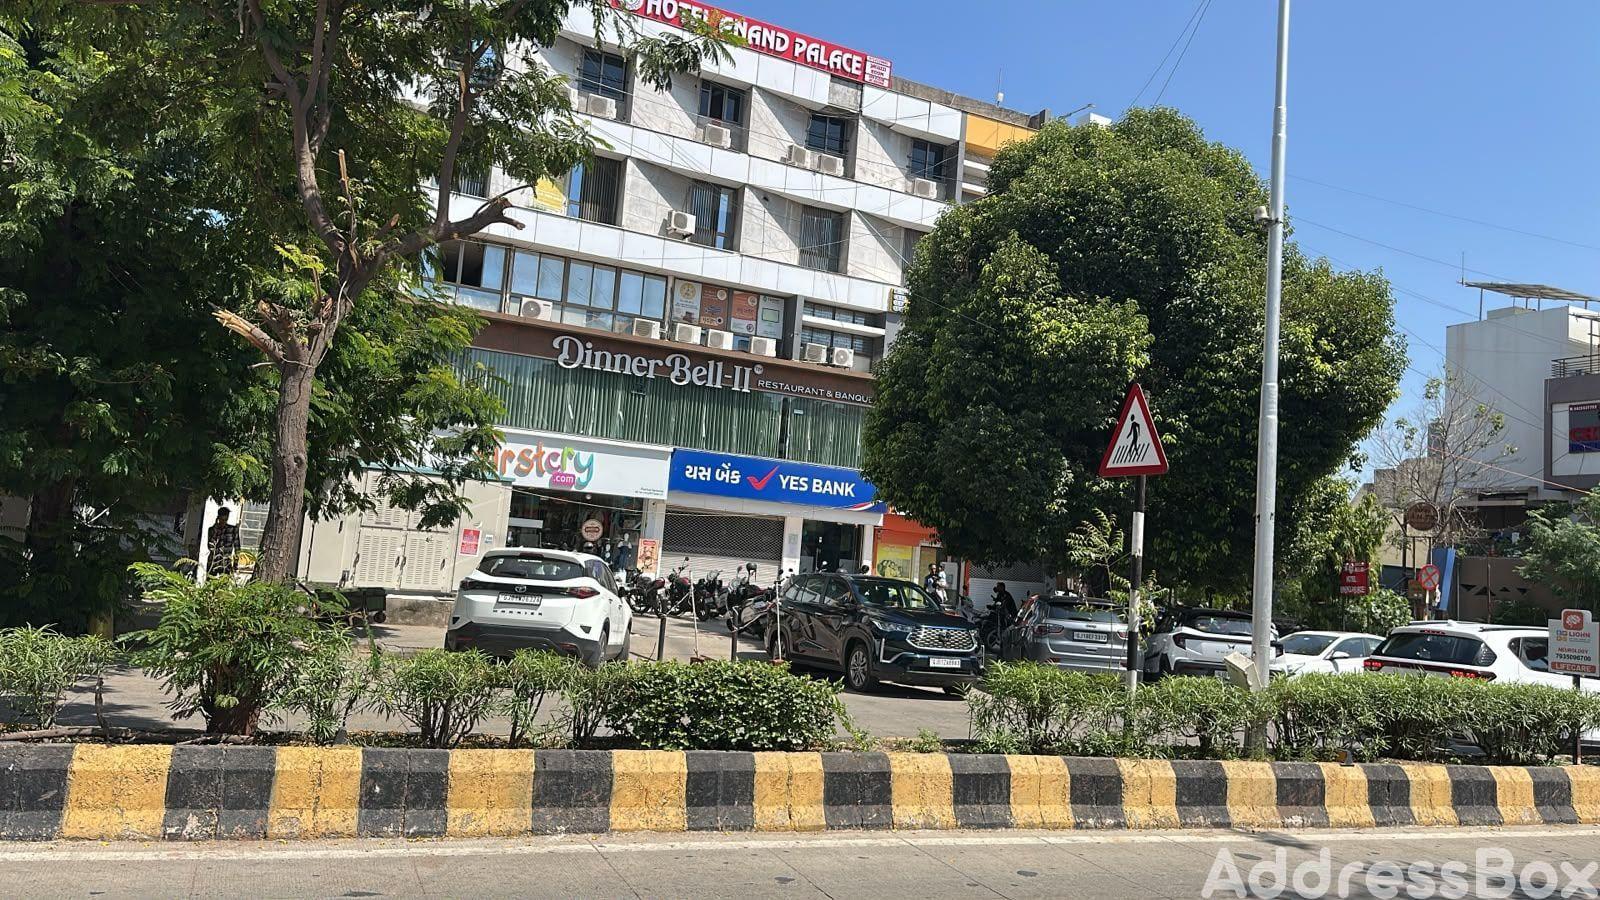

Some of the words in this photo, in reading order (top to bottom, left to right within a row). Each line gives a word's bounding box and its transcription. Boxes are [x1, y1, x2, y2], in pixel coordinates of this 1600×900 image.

[793, 37, 863, 76] PALACE
[552, 335, 664, 379] Dinner
[665, 353, 751, 393] Bell-II
[757, 380, 825, 396] RESTAURANT
[826, 390, 833, 398] &
[834, 391, 875, 404] BANQUE
[483, 440, 594, 489] irstcry
[685, 464, 711, 482] યસ
[715, 462, 742, 484] બેંક
[553, 474, 574, 484] .com
[779, 473, 808, 492] YES
[812, 478, 856, 498] BANK
[1556, 662, 1591, 671] LIFECARE
